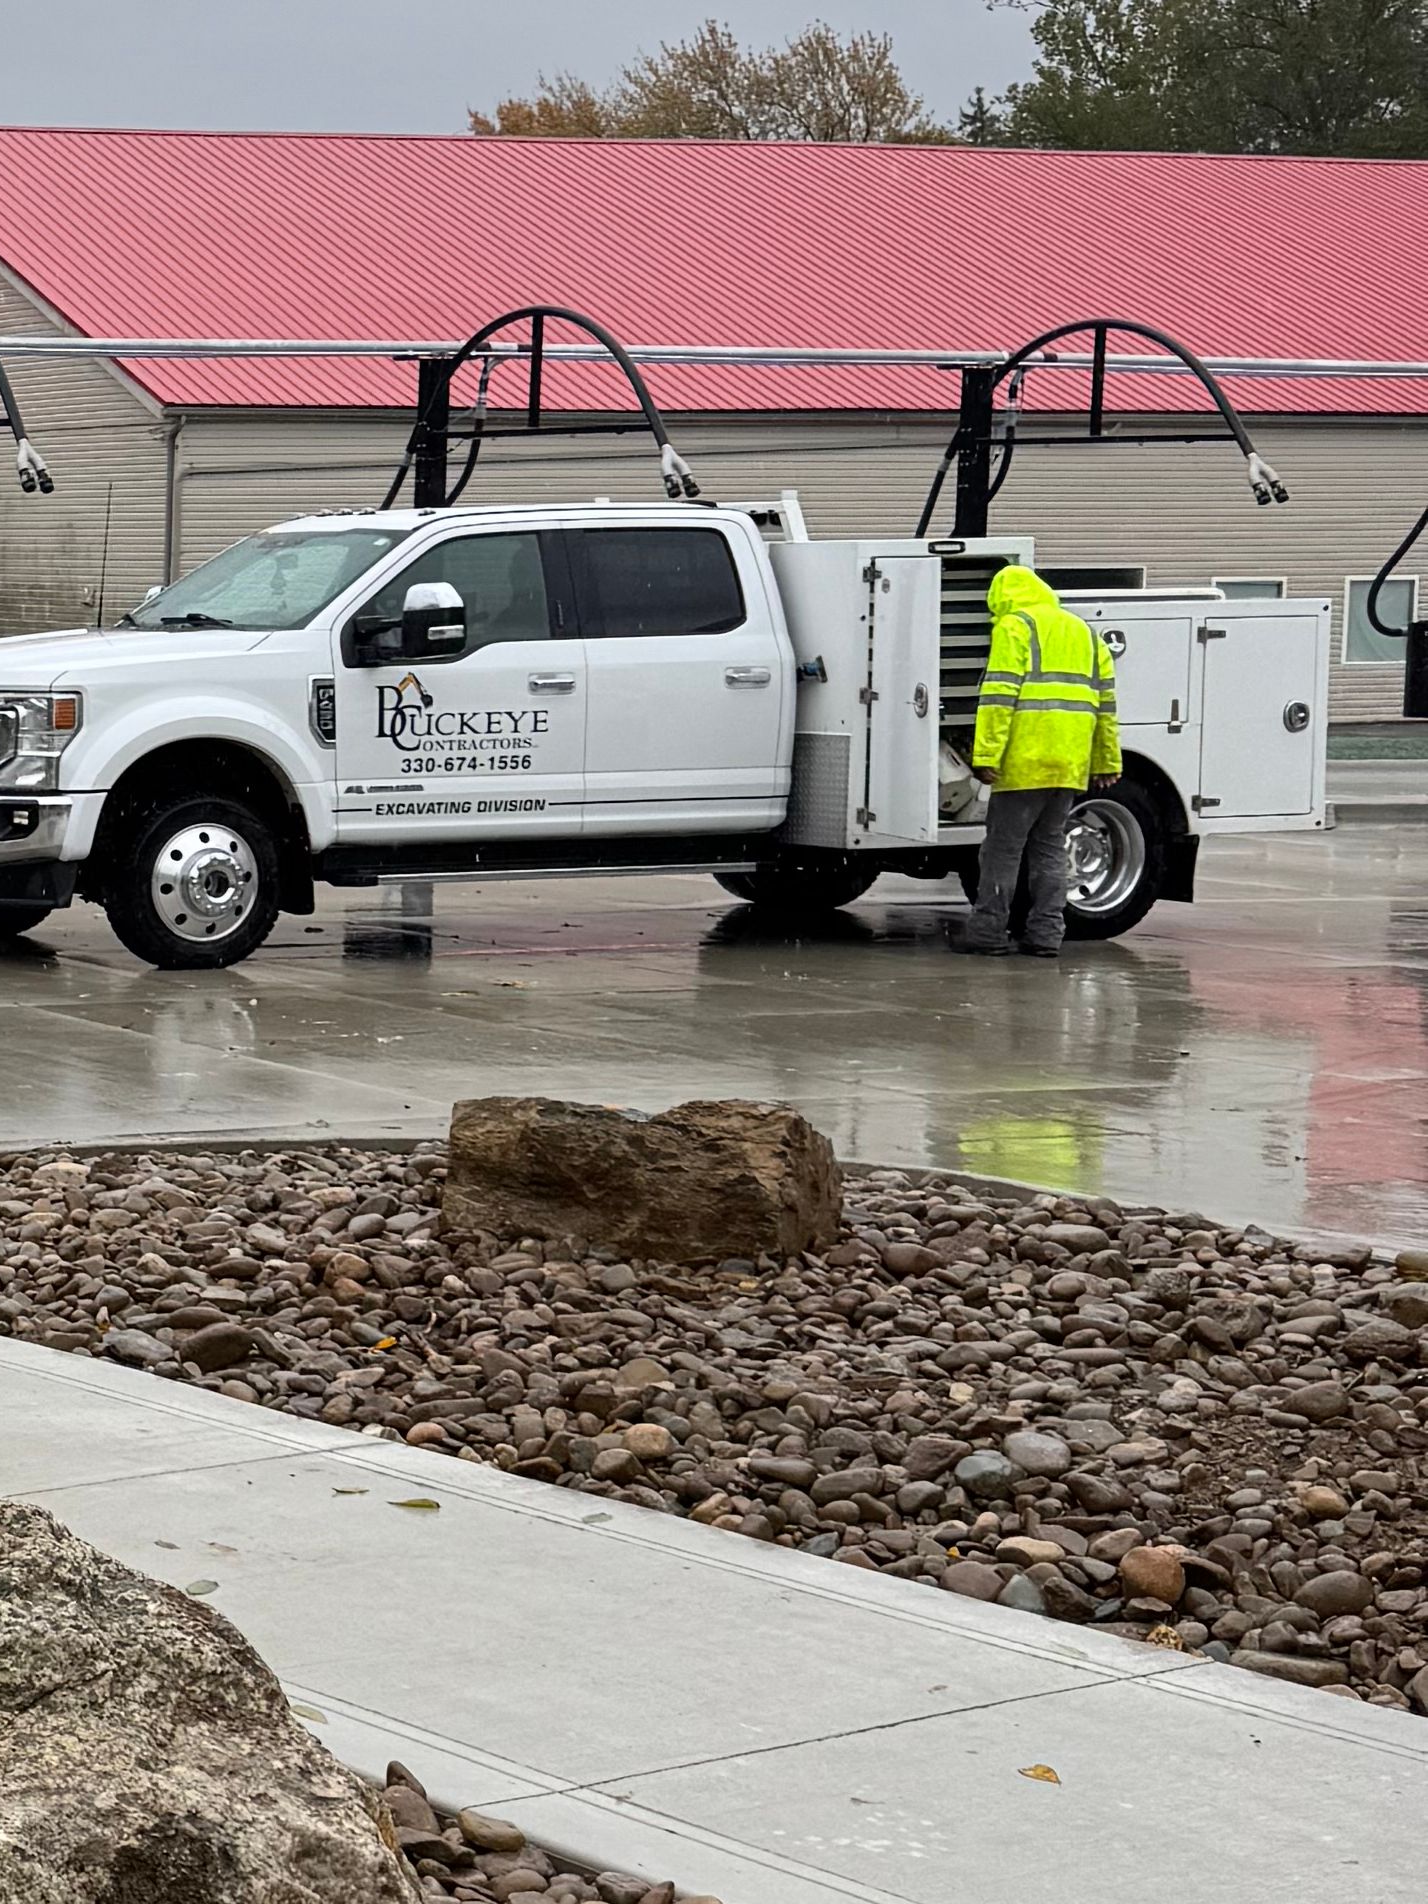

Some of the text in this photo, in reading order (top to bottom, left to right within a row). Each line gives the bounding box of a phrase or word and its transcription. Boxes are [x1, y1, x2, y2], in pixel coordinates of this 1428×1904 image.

[375, 685, 549, 738] BUCKEYE
[400, 754, 532, 774] 330-674-1556
[375, 799, 546, 816] EXCAVATING DIVISION
